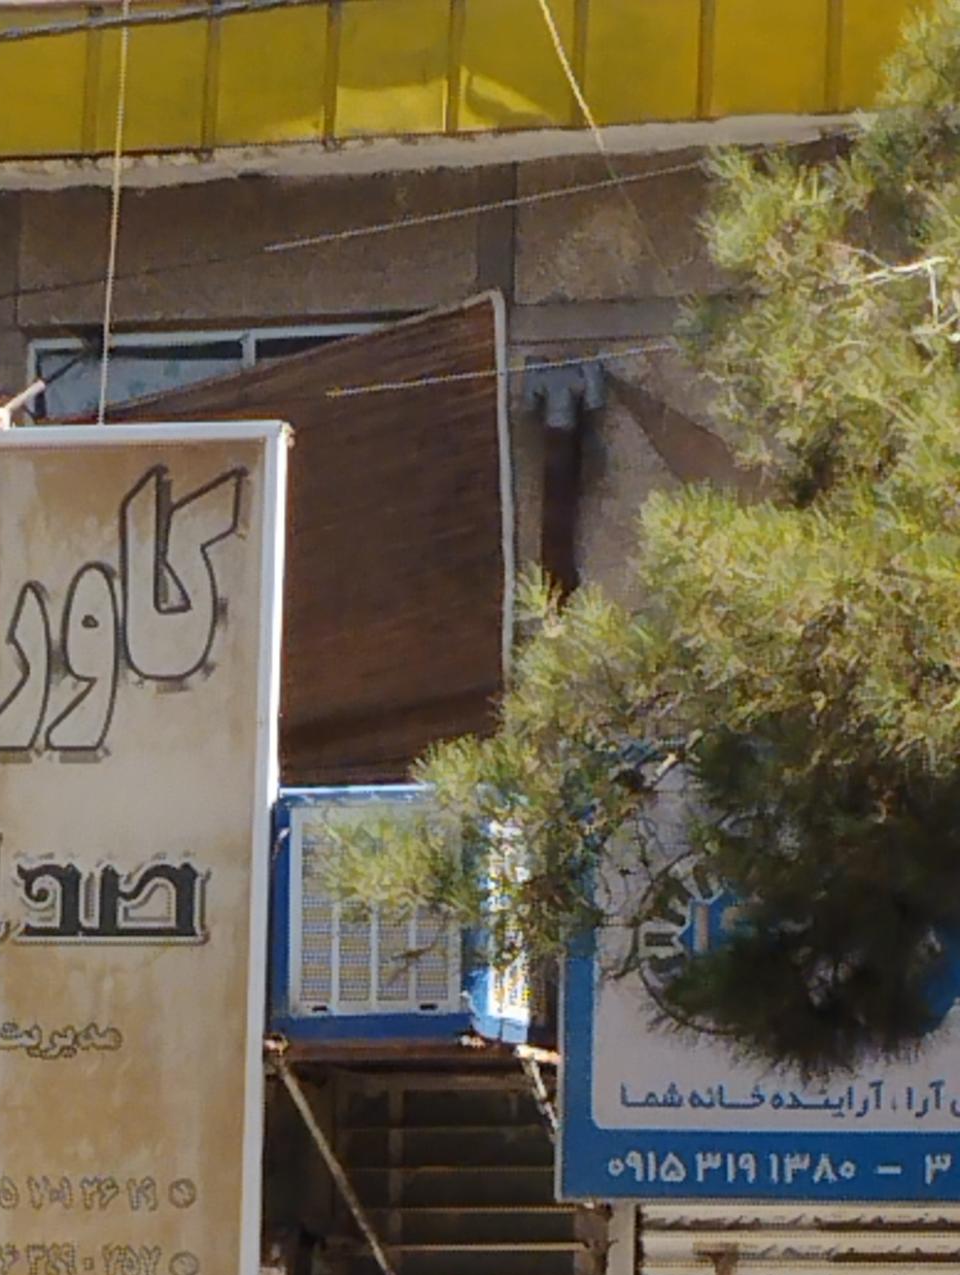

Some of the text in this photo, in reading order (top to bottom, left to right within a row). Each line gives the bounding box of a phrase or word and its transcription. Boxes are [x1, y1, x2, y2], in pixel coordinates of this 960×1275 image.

[620, 1082, 683, 1110] شما
[688, 1084, 766, 1110] خانه
[770, 1080, 884, 1118] آراینده
[607, 1151, 686, 1183] ۰۹۱۵
[695, 1152, 757, 1184] ۳۱۹
[768, 1152, 857, 1185] ۱۳۸۰
